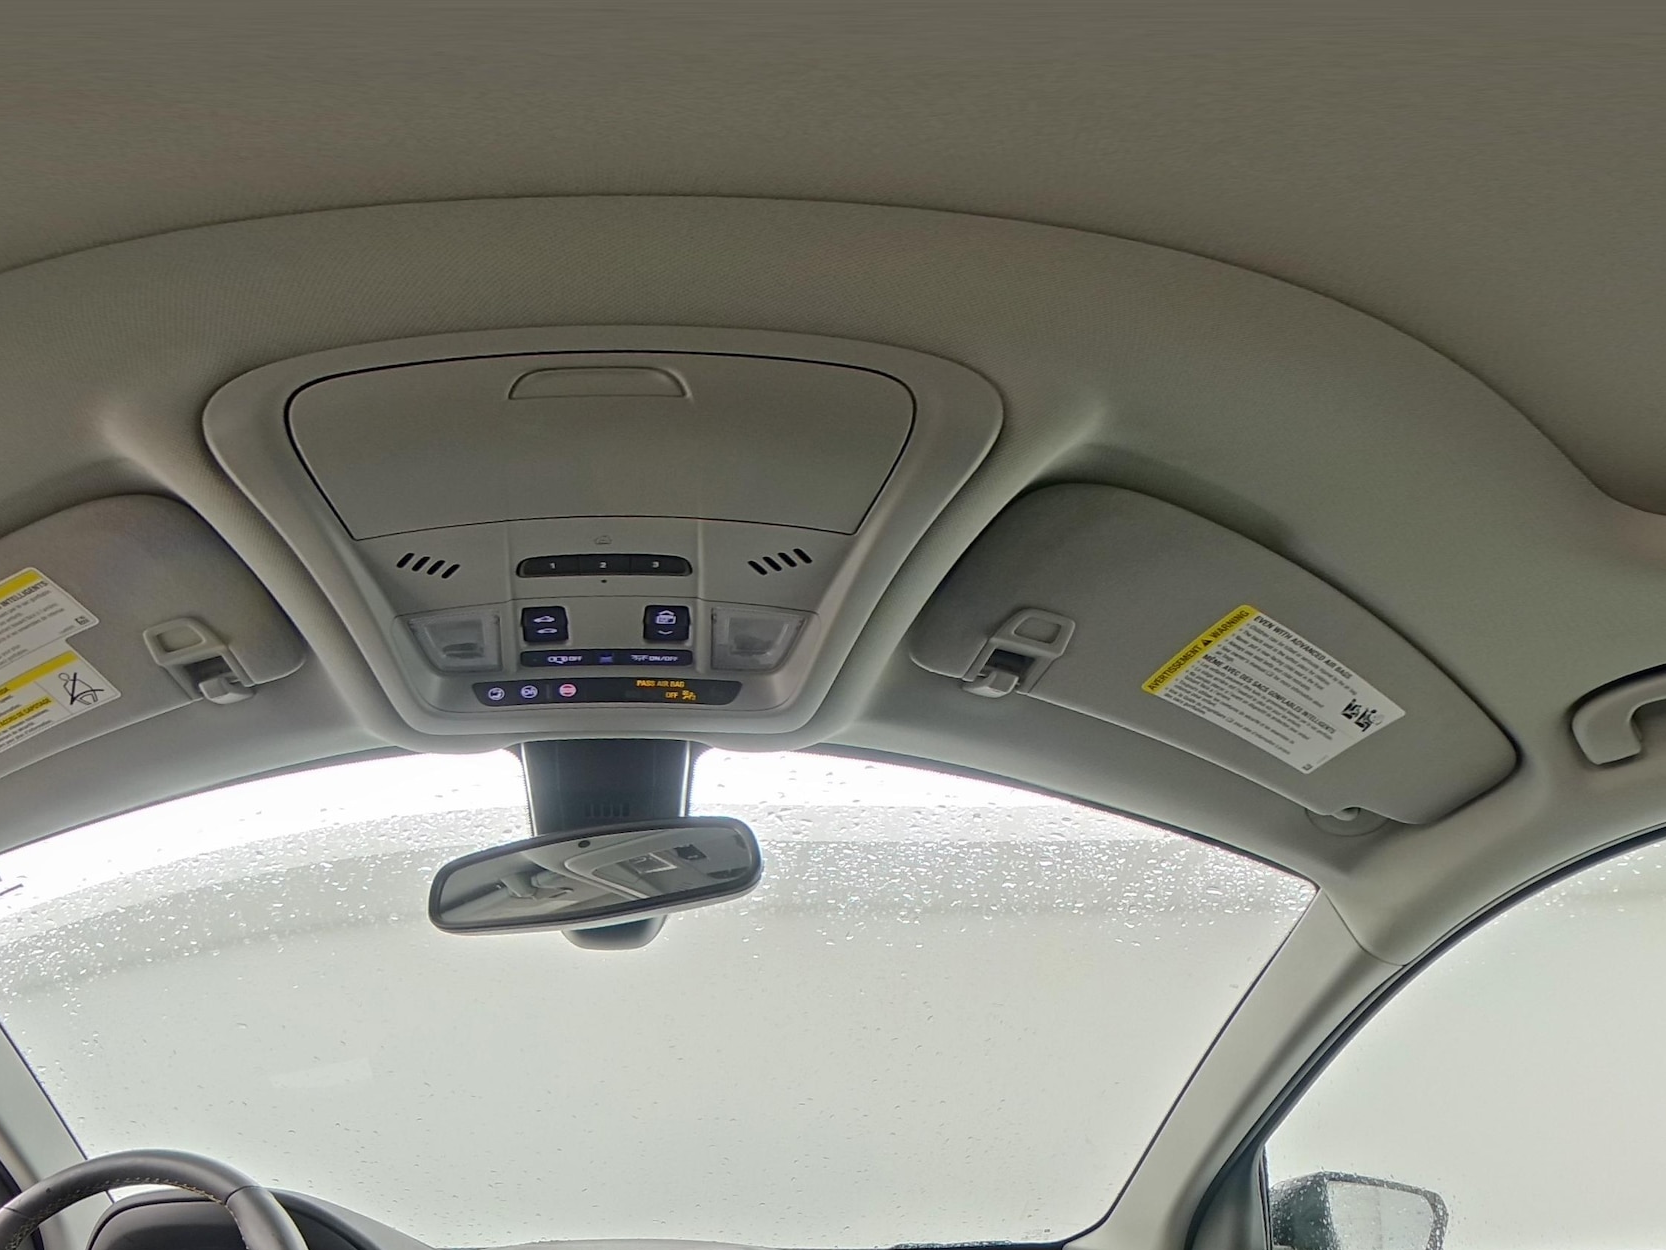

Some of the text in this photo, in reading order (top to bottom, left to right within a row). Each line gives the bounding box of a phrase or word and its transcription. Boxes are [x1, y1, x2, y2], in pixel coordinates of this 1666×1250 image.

[1147, 645, 1202, 691] AVERTISSEMENT
[1209, 610, 1250, 639] WARNING
[1253, 616, 1274, 629] EVEN
[1273, 626, 1293, 640] WITH
[1291, 637, 1326, 661] ADVANCED
[636, 680, 655, 688] PASS
[665, 691, 678, 699] OFF
